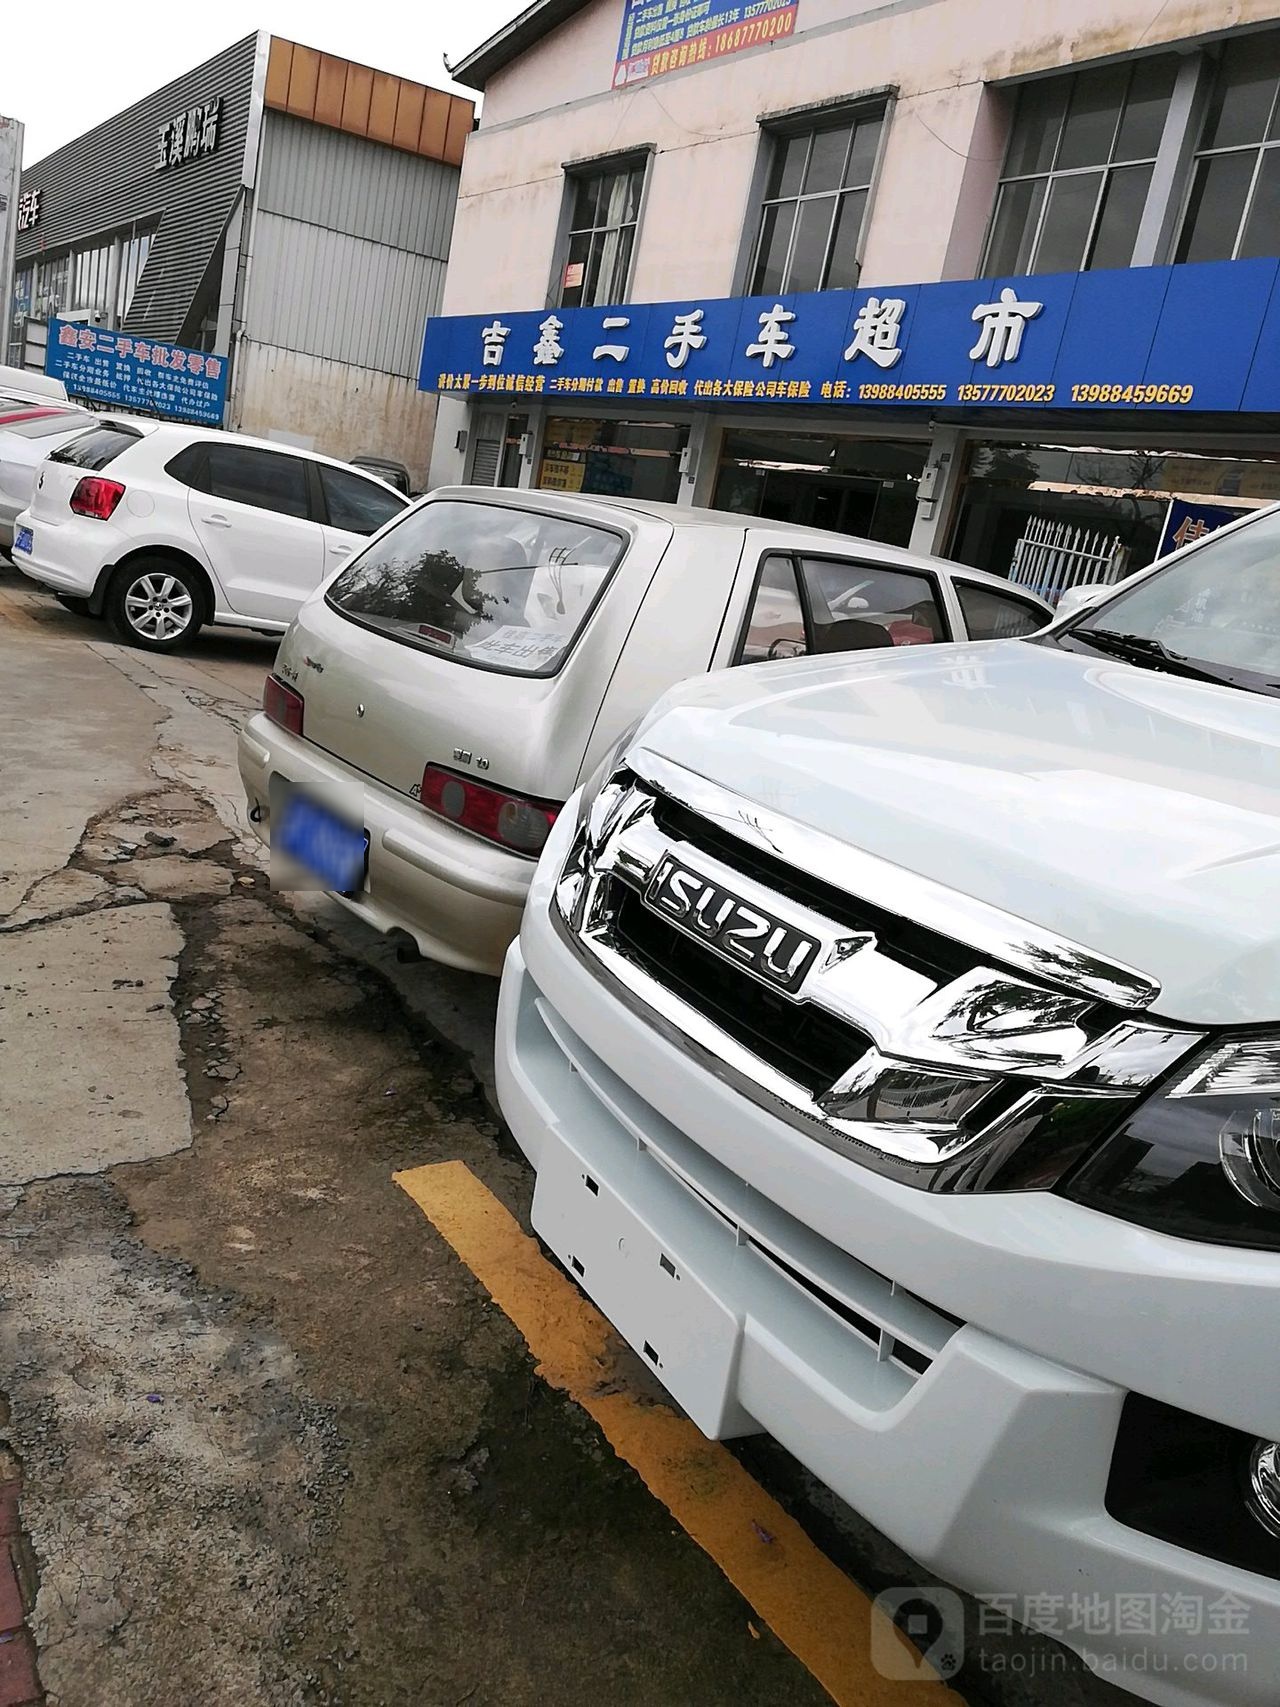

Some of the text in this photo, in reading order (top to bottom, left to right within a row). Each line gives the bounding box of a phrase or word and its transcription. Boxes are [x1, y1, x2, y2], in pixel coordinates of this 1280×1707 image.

[715, 12, 792, 53] 18687770200
[59, 324, 221, 380] 鑫安二手车批发零售
[481, 287, 1044, 370] 吉鑫二手车超市
[549, 377, 603, 393] 二手车分期付款
[650, 378, 688, 395] 高价回收
[693, 381, 812, 398] 代出各大保险公司车保险
[858, 383, 946, 401] 13988405555
[956, 383, 1056, 402] 13577702023
[1070, 383, 1194, 404] 13988459669
[650, 861, 813, 983] ISUZU
